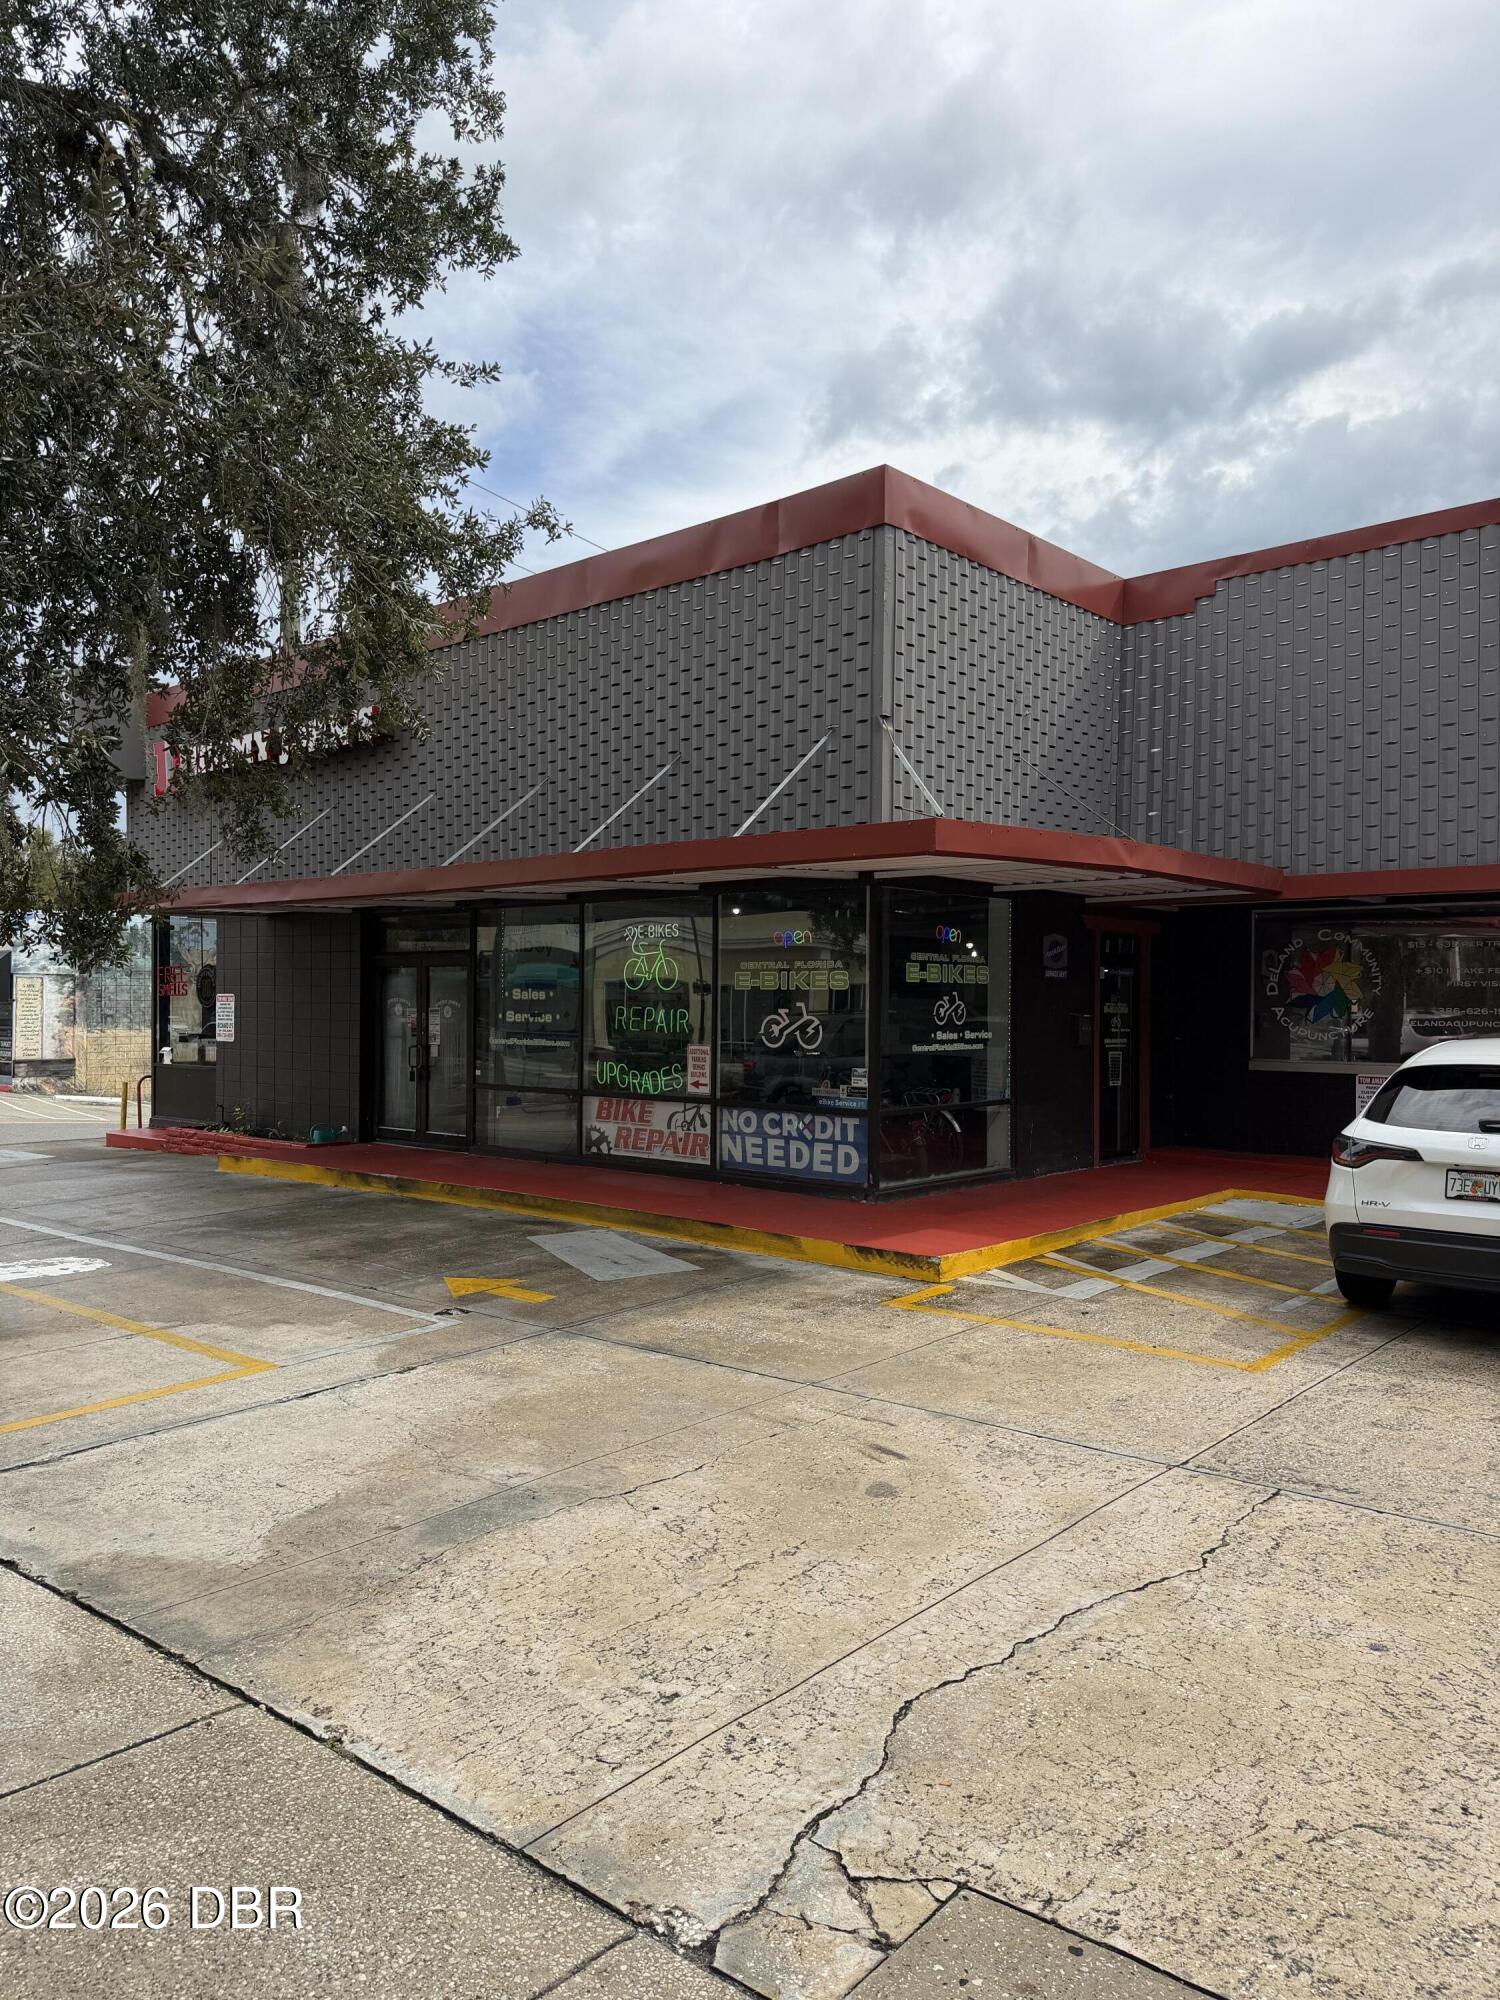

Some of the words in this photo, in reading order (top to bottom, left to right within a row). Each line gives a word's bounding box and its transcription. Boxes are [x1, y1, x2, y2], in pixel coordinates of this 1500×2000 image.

[638, 923, 680, 939] E-BIKES
[740, 960, 790, 969] CENTRAL
[794, 960, 843, 969] FLORIDA
[910, 952, 949, 962] CENTRAL
[1317, 928, 1382, 997] COMMUNITY
[734, 970, 850, 991] E-BIKES
[905, 962, 990, 984] E-BIKES
[512, 988, 546, 1000] Sales
[505, 1010, 553, 1023] Service
[615, 1005, 689, 1034] REPAIR
[936, 1030, 958, 1040] Sales
[964, 1029, 993, 1039] Service
[596, 1059, 683, 1095] UPGRADES
[596, 1097, 656, 1124] BIKE
[722, 1108, 757, 1134] NO
[613, 1125, 710, 1158] REPAIR
[721, 1133, 860, 1175] NEEDED
[1449, 1177, 1470, 1193] 73E
[1361, 1199, 1391, 1208] HR-V
